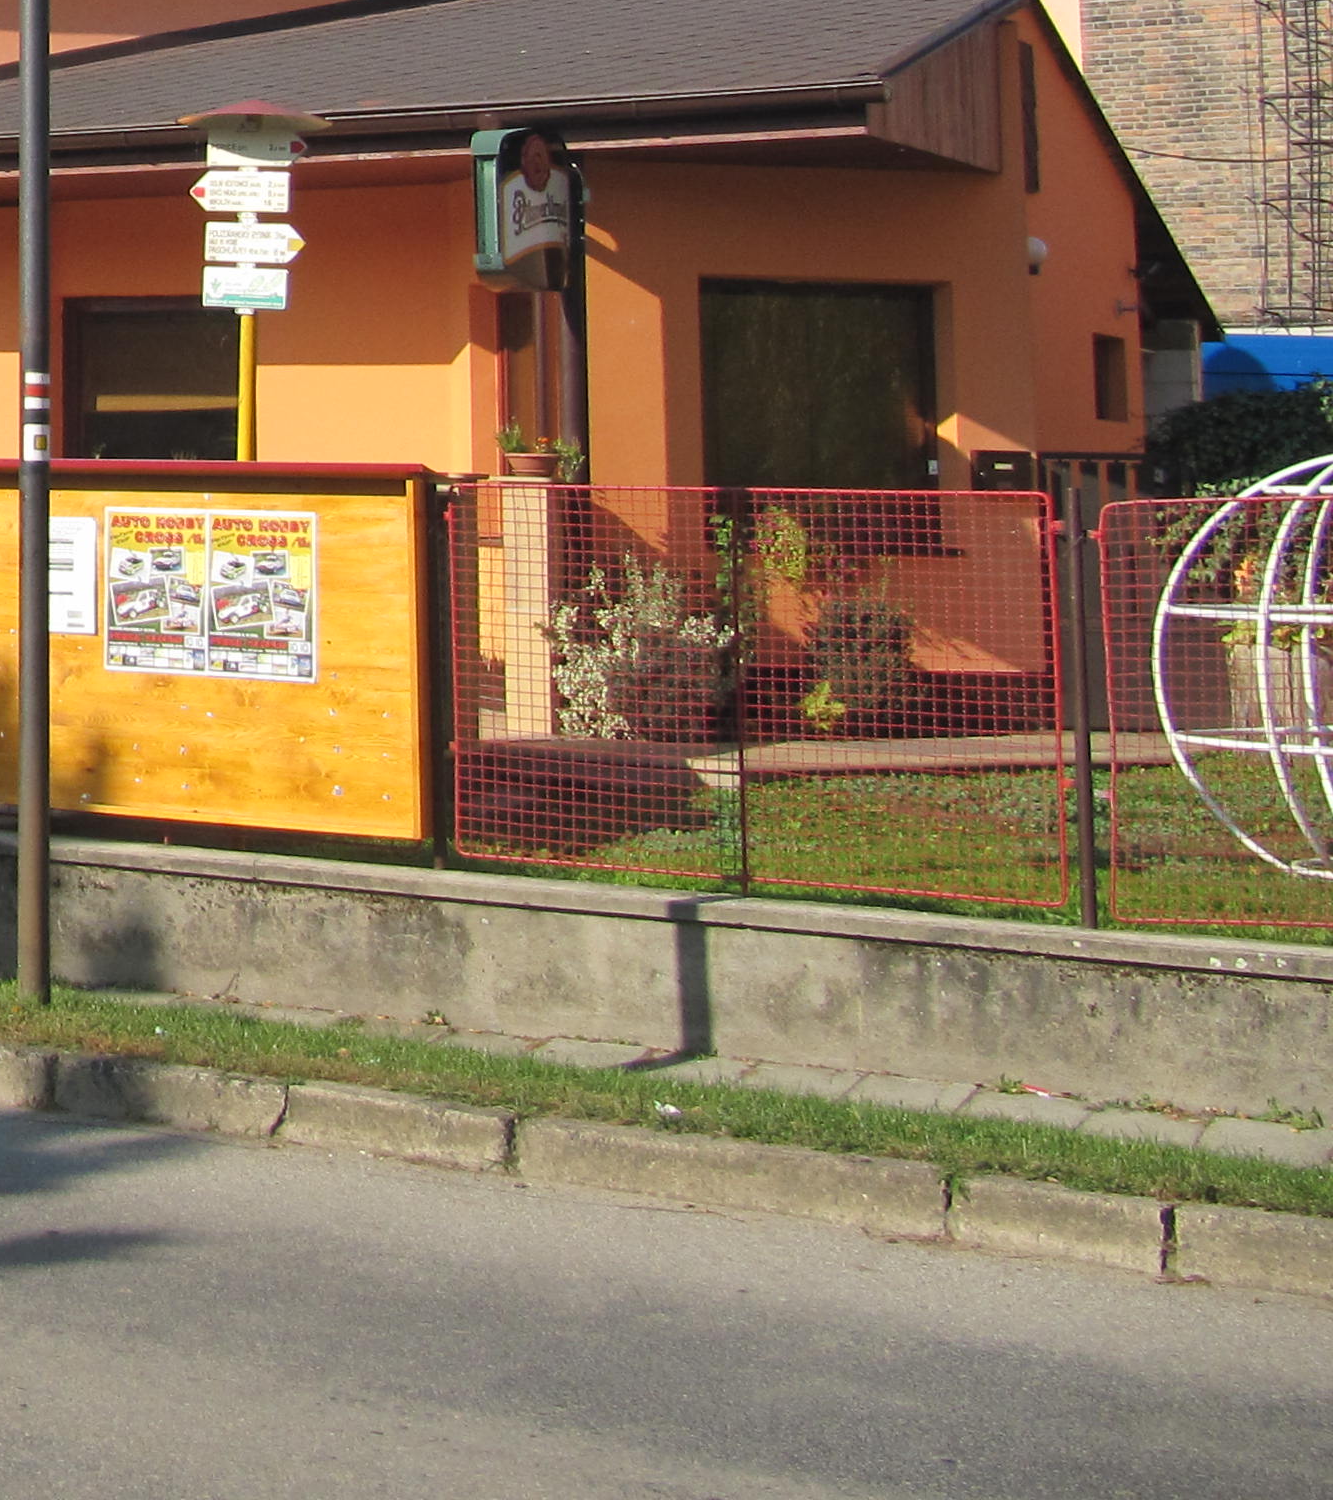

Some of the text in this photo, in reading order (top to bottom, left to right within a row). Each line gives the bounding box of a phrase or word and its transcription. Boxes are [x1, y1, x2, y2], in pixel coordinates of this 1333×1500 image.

[111, 516, 206, 530] AUTO HOBBY
[212, 518, 311, 534] AUTO HOBBY
[135, 531, 184, 544] CROSS
[237, 534, 287, 548] CROSS
